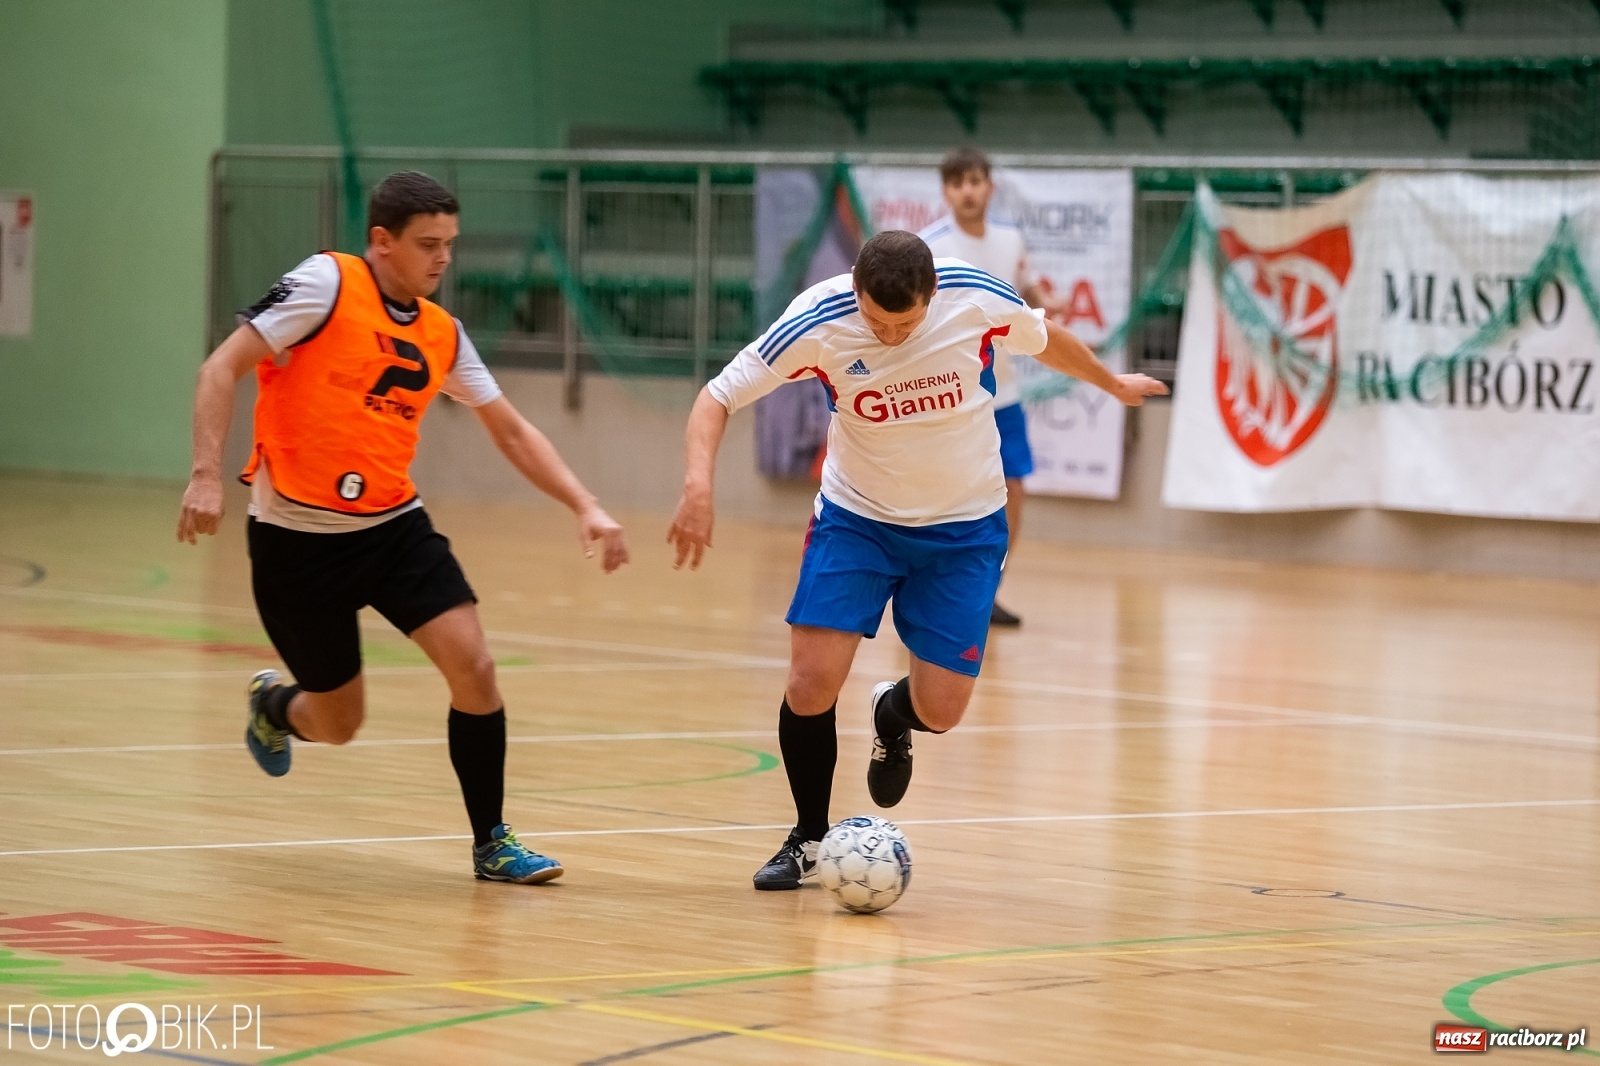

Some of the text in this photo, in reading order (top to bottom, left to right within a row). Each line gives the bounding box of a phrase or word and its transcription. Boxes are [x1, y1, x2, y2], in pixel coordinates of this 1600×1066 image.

[1381, 269, 1567, 331] MIASTO
[845, 368, 871, 376] adidas
[884, 371, 960, 396] CUKIERNIA
[1356, 339, 1595, 415] RACIBÓRZ
[853, 382, 964, 423] Gianni
[340, 473, 364, 500] 6
